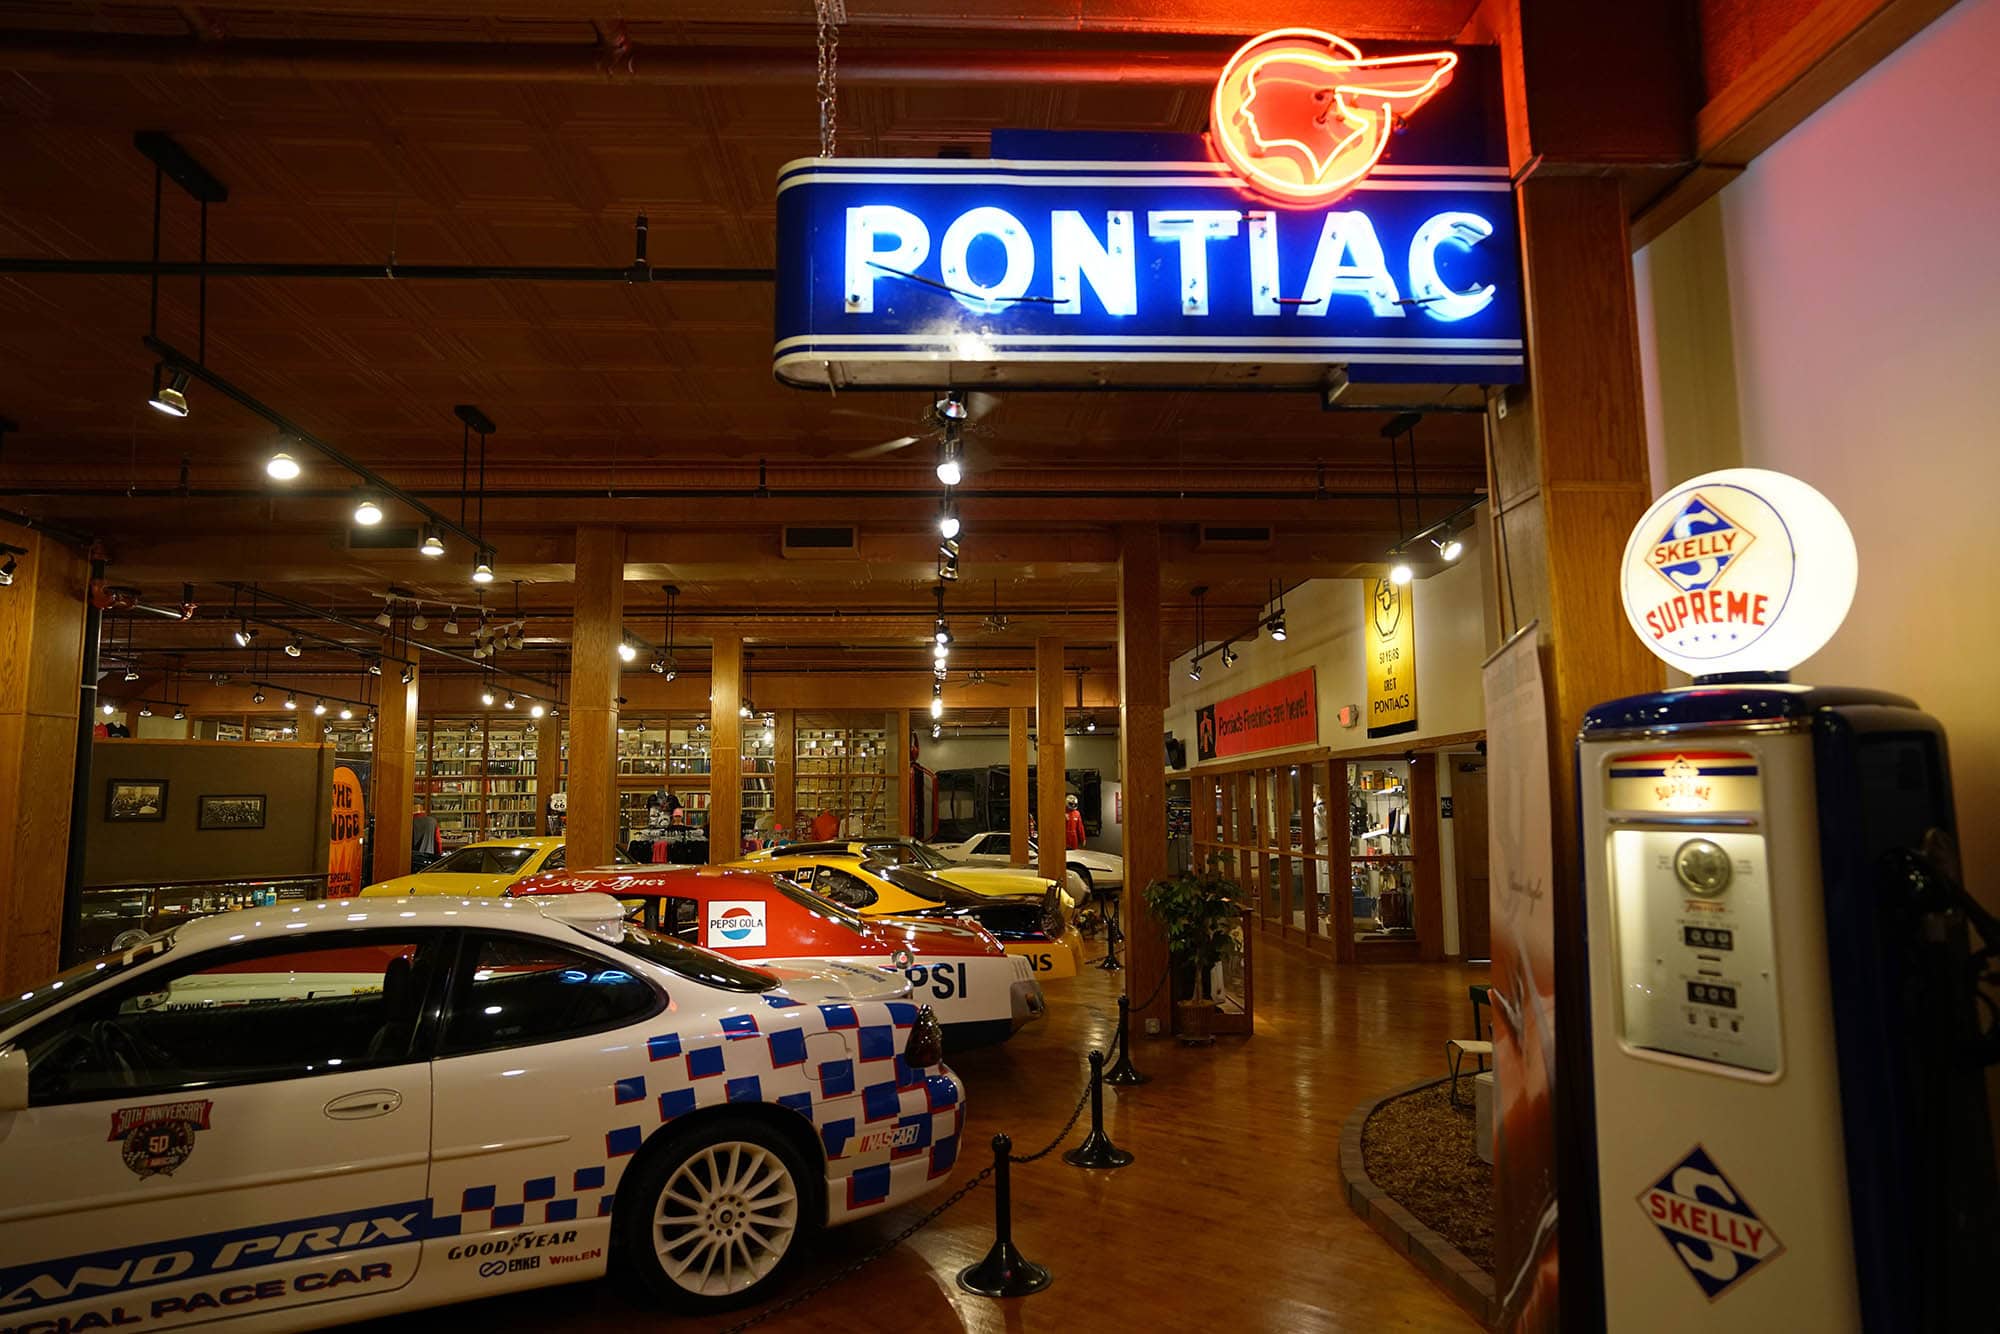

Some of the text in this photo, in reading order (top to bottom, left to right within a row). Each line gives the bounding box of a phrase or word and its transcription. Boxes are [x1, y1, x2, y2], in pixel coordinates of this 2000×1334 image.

[844, 203, 1497, 322] PONTIAC
[1654, 532, 1738, 565] SKELLY
[1645, 589, 1769, 640] SUPREME
[1374, 693, 1410, 714] PONTIACS
[553, 801, 566, 809] 66
[1654, 783, 1712, 801] SUPME
[798, 870, 813, 880] CAT
[710, 918, 764, 929] PEPSI COLA
[119, 1101, 207, 1132] 50TH ANNIVERSARY
[149, 1135, 170, 1153] 50
[869, 1126, 916, 1151] NASCAR
[1649, 1192, 1764, 1253] SKELLY
[211, 1212, 419, 1269] PRIX
[508, 1247, 602, 1273] ENKEI WHELEN
[151, 1279, 287, 1318] PACE
[293, 1262, 393, 1293] CAR
